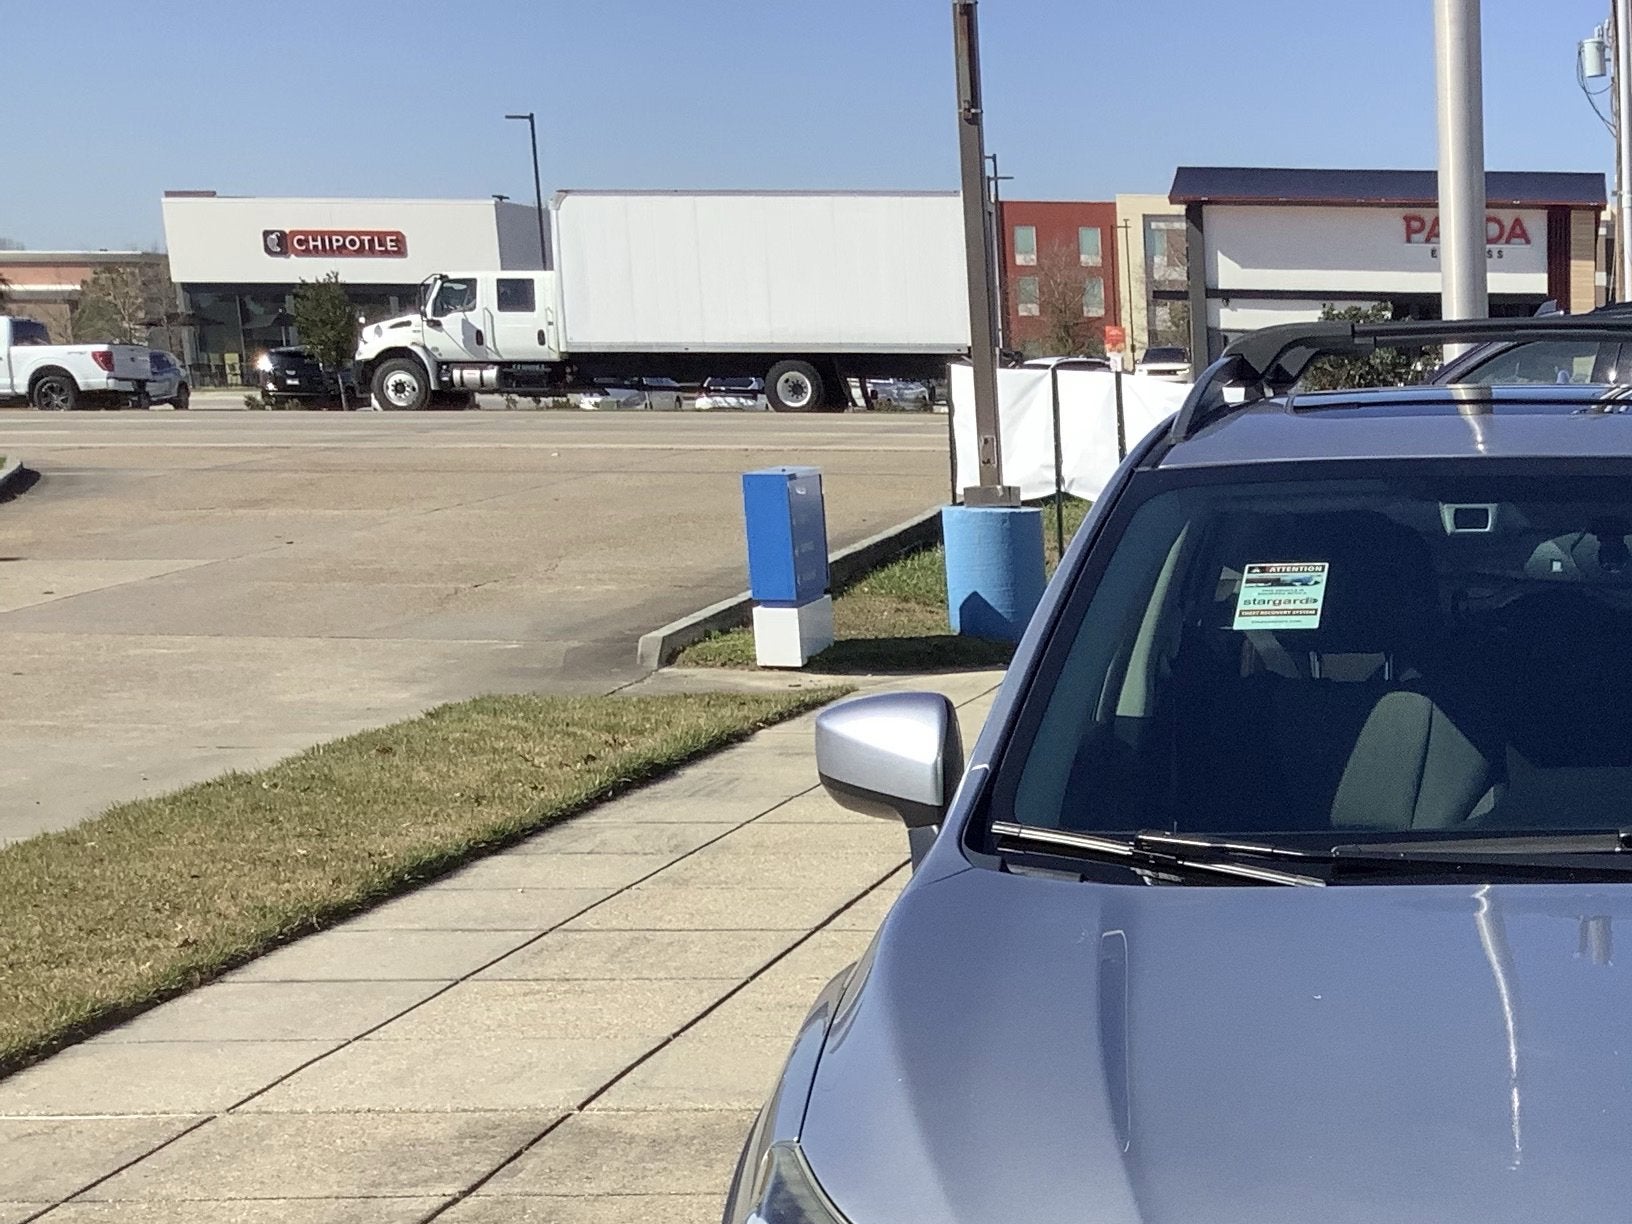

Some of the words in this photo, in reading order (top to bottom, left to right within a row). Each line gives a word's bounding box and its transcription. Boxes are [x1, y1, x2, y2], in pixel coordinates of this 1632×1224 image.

[1403, 215, 1531, 244] PADA
[293, 235, 398, 250] CHIPOTLE
[1268, 565, 1323, 573] ATTENTION
